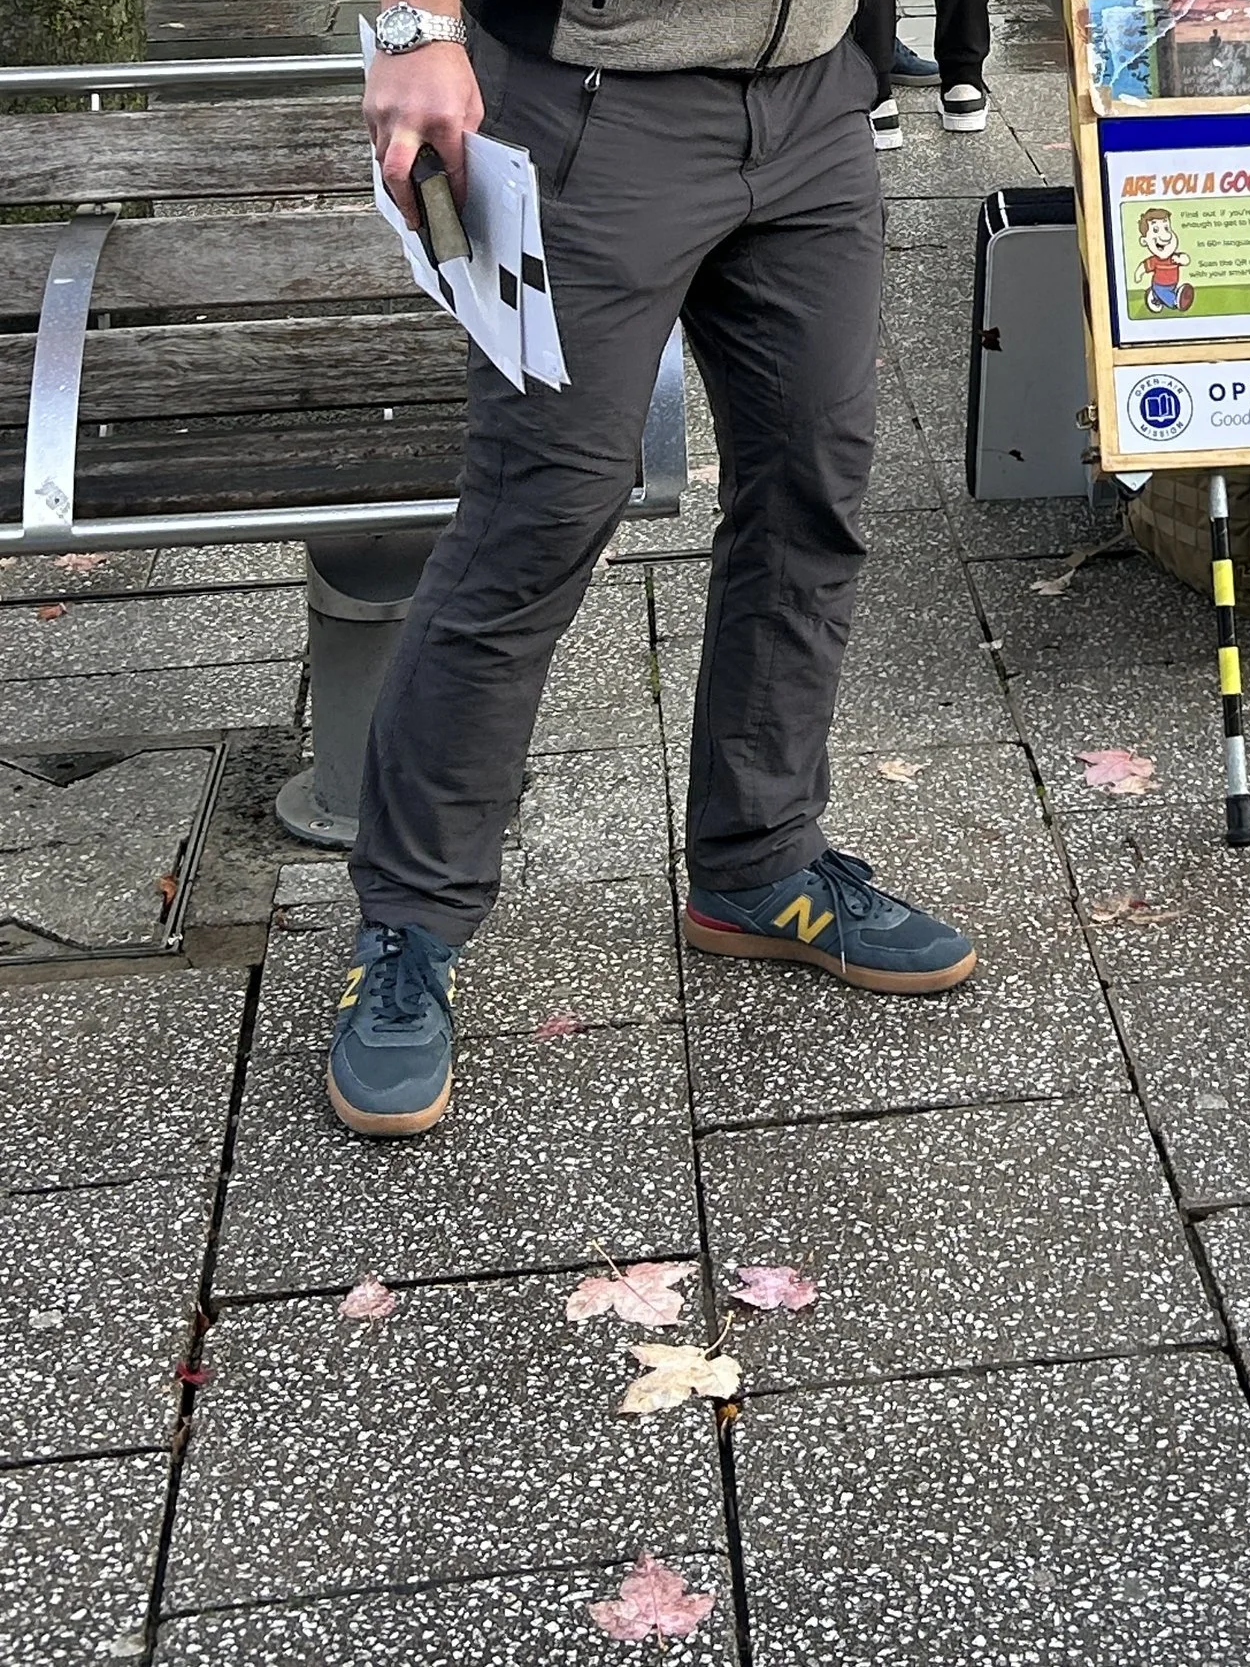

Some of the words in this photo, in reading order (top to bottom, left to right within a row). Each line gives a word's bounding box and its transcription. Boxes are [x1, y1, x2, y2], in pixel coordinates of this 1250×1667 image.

[1122, 174, 1156, 197] ARE
[1162, 173, 1198, 195] YOU
[1201, 172, 1214, 193] A
[1135, 379, 1183, 396] OPEN-AIR
[1210, 409, 1250, 428] Good
[1140, 421, 1183, 437] MISSION
